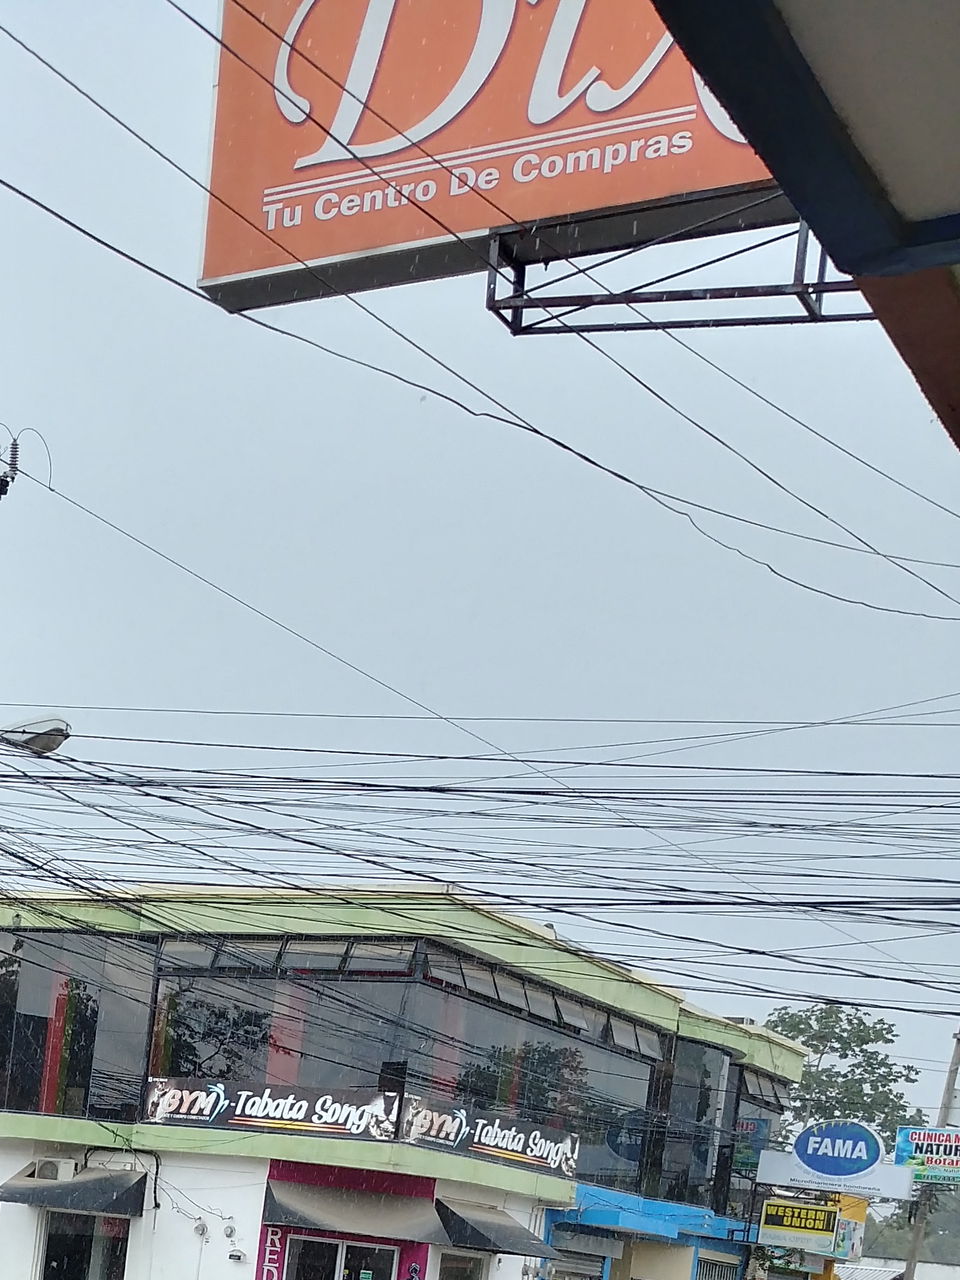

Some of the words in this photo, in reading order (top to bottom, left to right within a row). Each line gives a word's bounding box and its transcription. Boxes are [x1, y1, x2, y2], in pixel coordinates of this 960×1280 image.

[262, 201, 302, 231] Tu
[314, 177, 438, 221] Centro
[449, 165, 500, 197] De
[513, 130, 694, 184] Compras
[164, 1089, 216, 1116] GYM
[311, 1095, 372, 1135] Song
[526, 1130, 566, 1169] Song
[806, 1136, 868, 1160] FAMA
[767, 1205, 825, 1220] WESTERN
[783, 1216, 824, 1230] UNION
